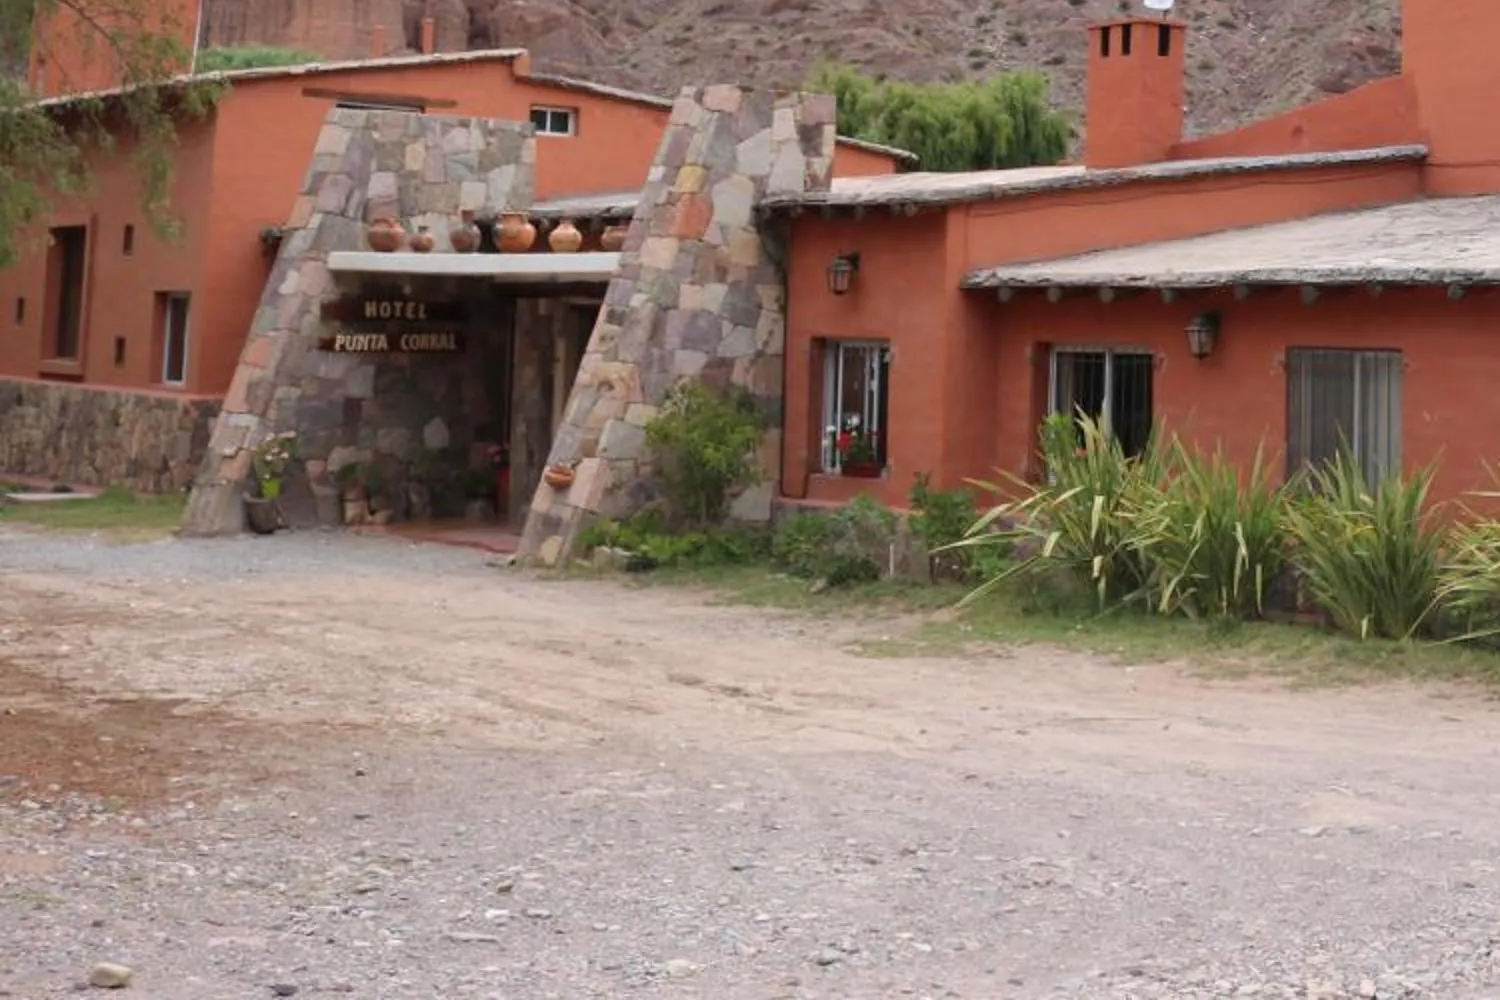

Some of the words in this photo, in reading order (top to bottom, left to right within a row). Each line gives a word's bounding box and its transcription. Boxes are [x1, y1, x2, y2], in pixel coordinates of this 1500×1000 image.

[364, 301, 427, 320] HOTEL
[335, 333, 389, 351] PUNTA
[400, 333, 457, 350] CORRAL
